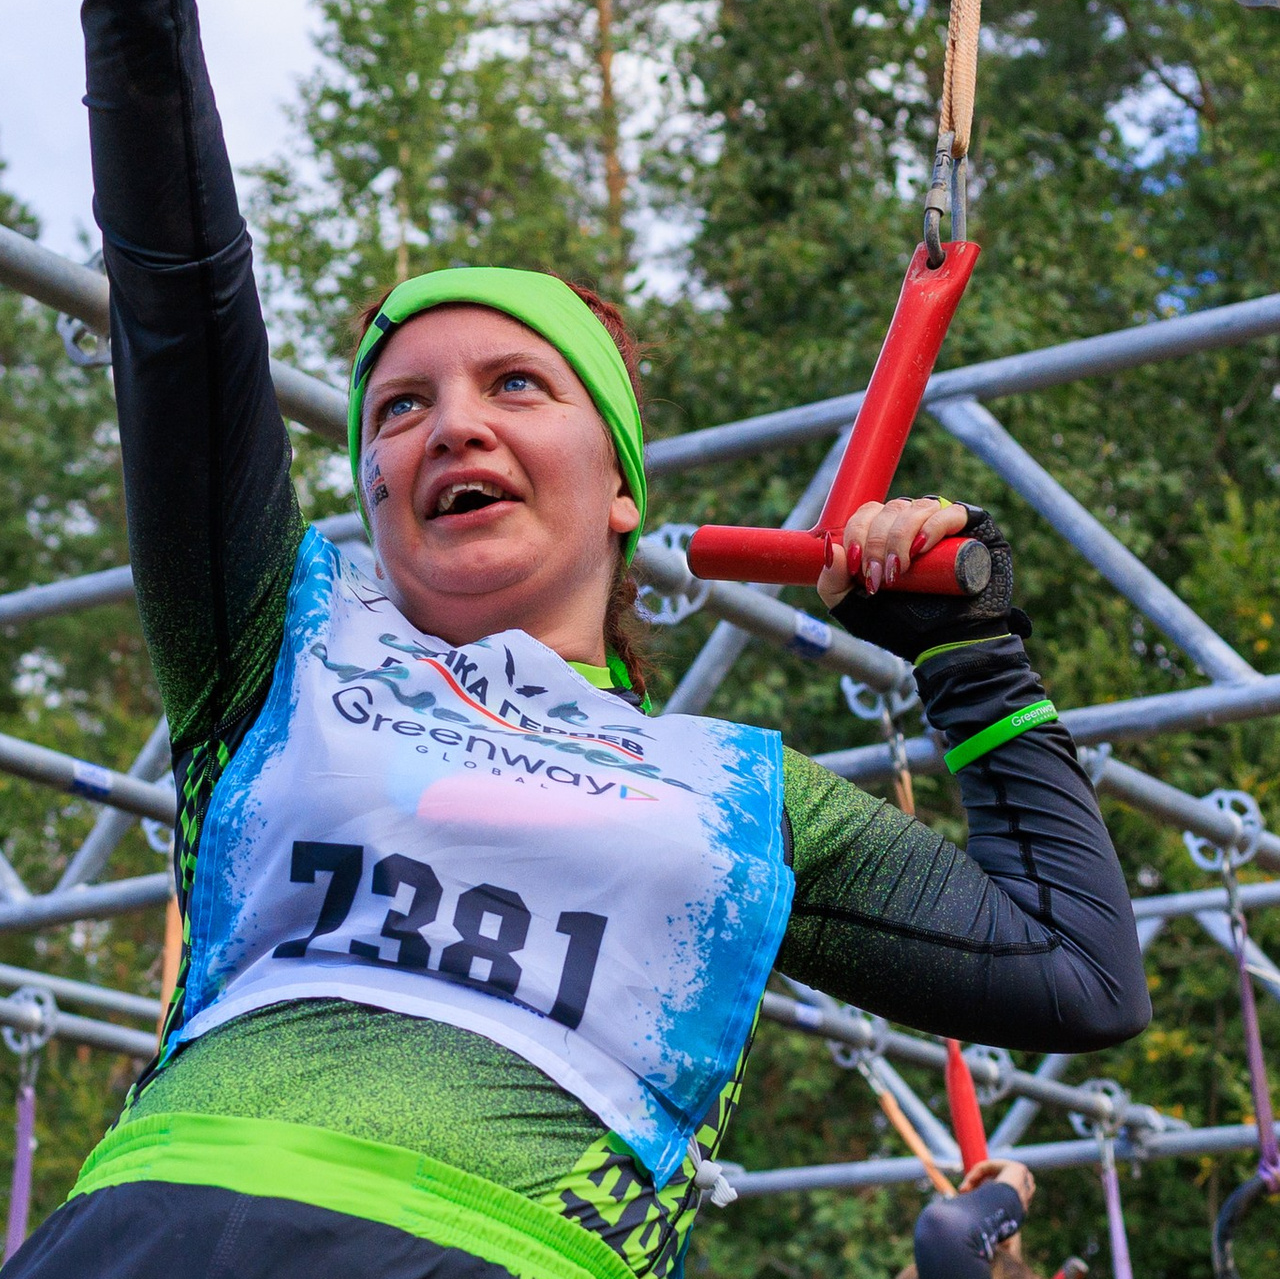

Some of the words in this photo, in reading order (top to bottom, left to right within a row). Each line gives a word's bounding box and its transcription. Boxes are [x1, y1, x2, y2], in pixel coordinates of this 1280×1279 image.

[332, 686, 616, 795] Greenway
[499, 698, 645, 756] ГЕРОЕВ
[1011, 704, 1056, 727] Greenwa
[415, 744, 549, 790] GLOBAL
[273, 841, 608, 1030] 7381
